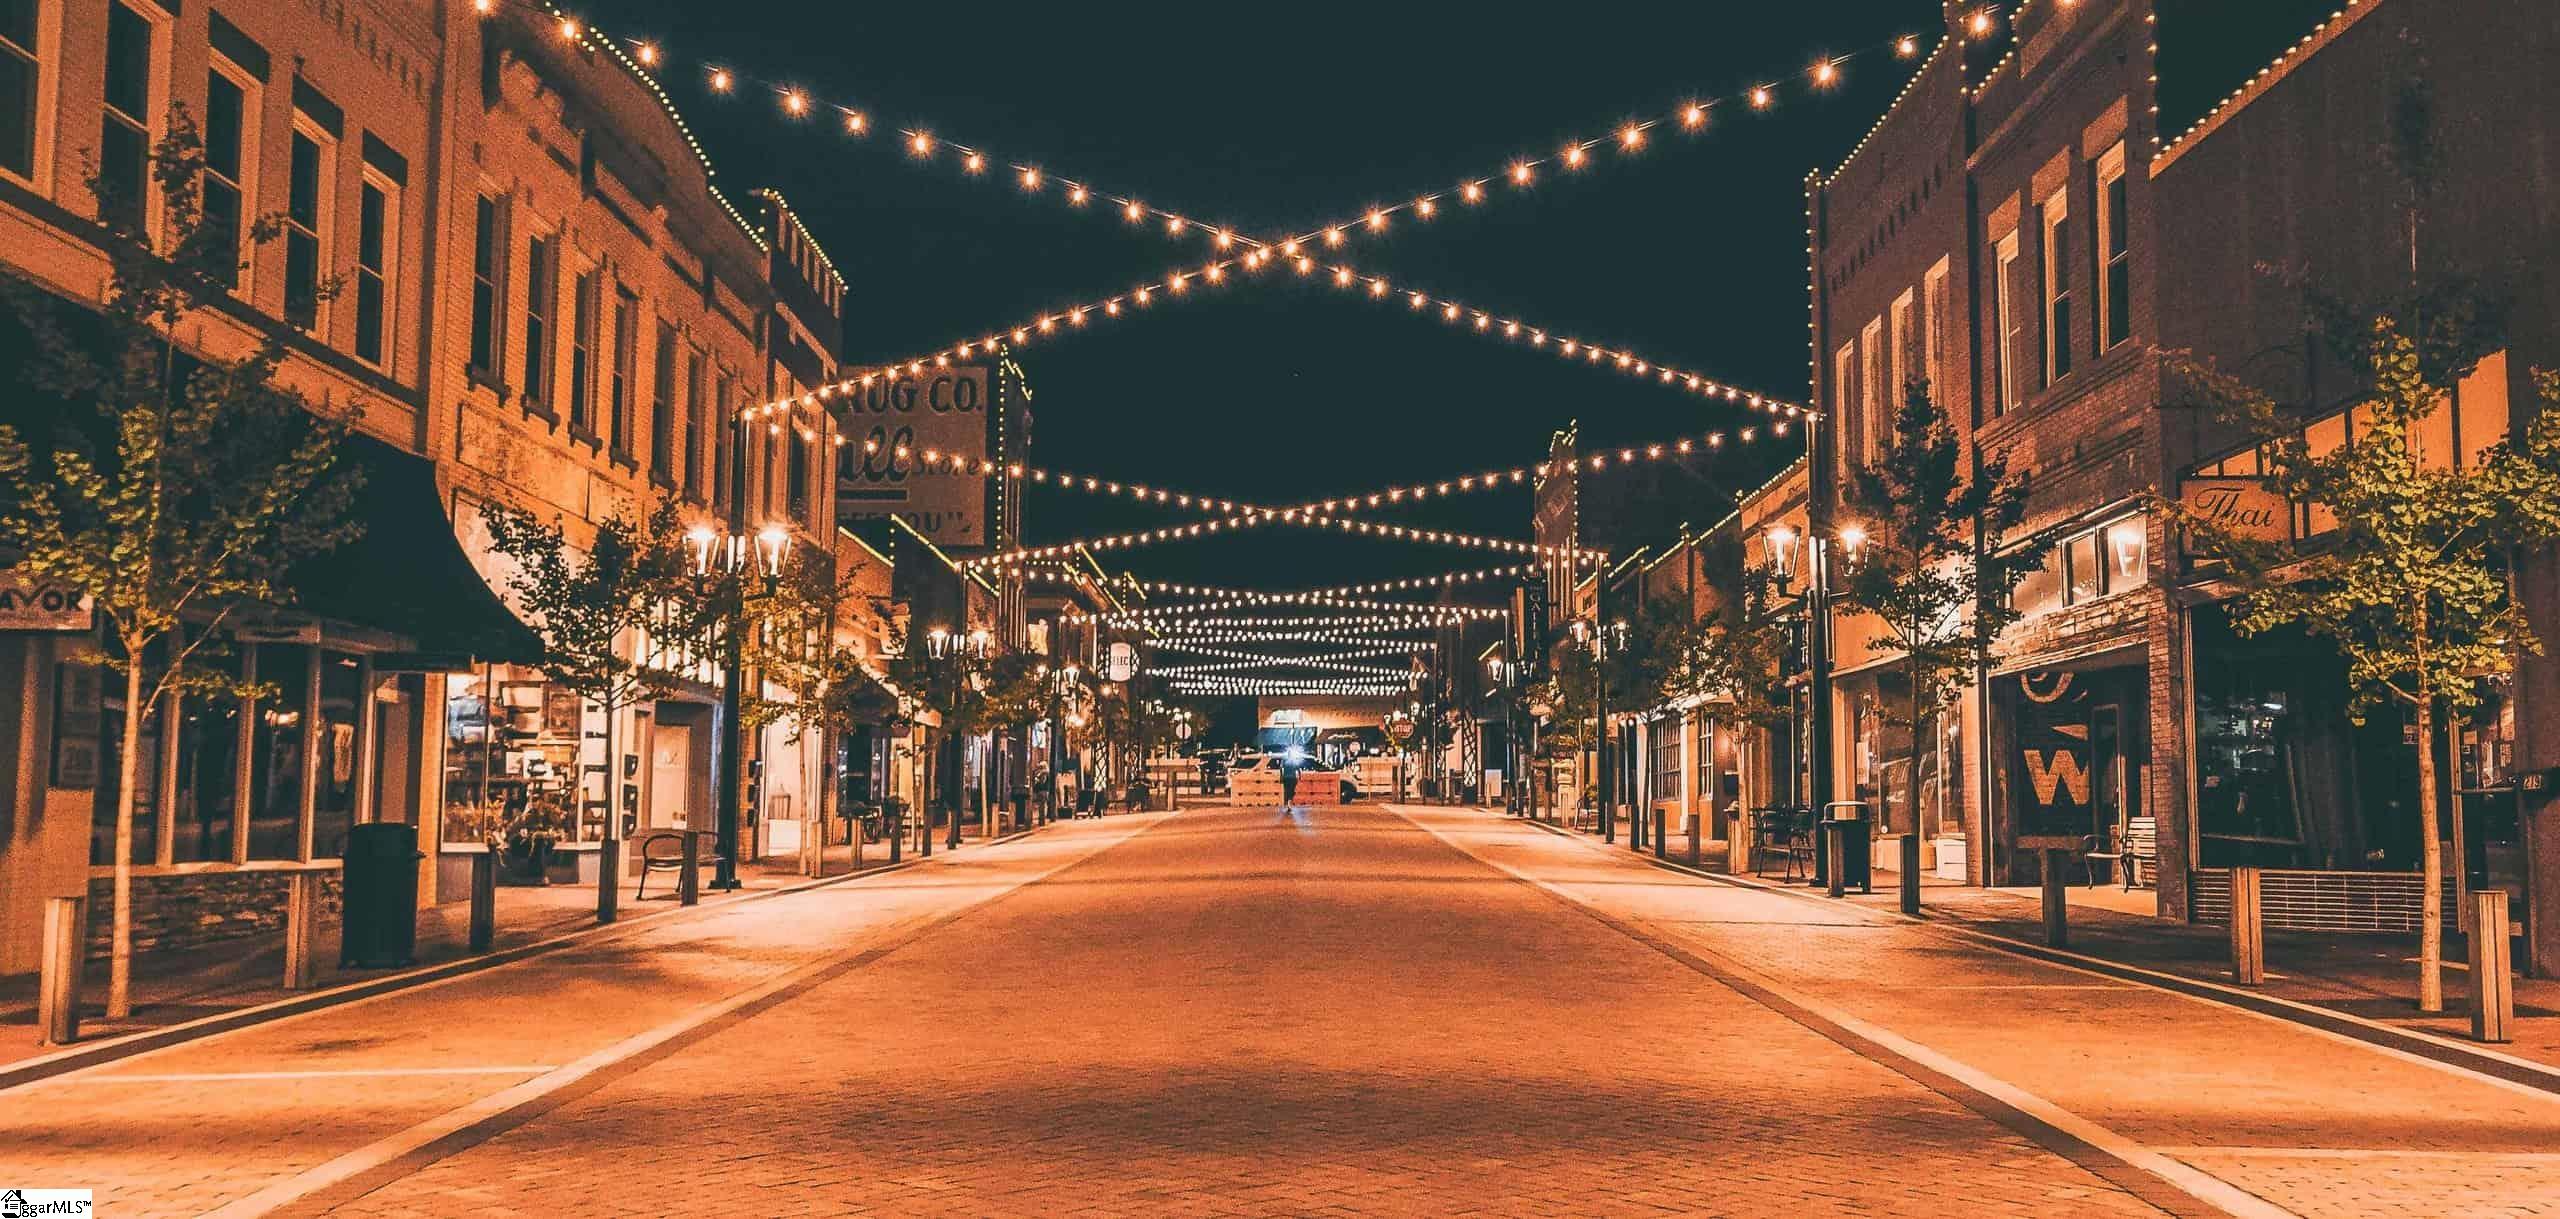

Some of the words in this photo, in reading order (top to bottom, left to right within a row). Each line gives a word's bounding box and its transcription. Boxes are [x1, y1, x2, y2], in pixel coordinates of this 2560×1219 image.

[928, 374, 983, 413] CO.
[2195, 486, 2274, 527] Thai
[2023, 749, 2090, 805] W
